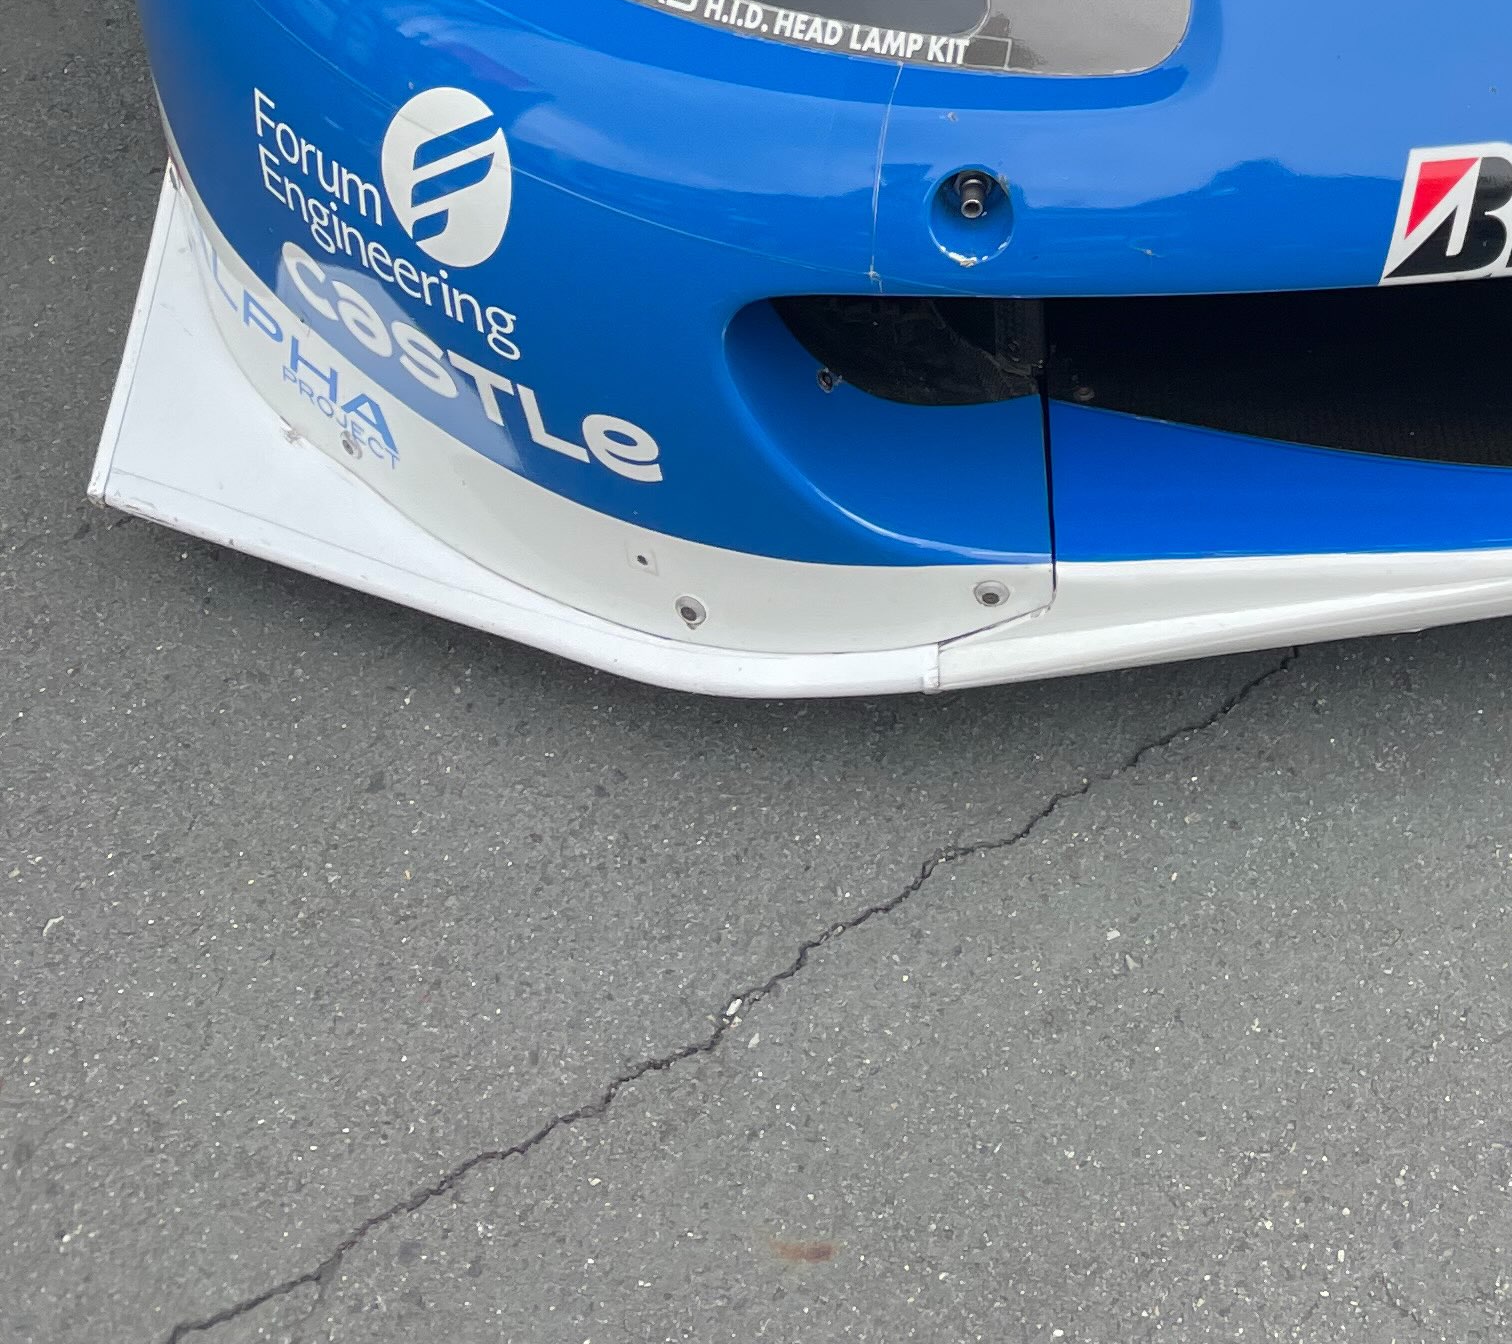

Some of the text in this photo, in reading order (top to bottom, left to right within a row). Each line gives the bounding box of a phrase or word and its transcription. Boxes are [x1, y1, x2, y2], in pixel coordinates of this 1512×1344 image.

[773, 9, 844, 46] HEAD
[849, 24, 924, 59] LAMP
[926, 36, 970, 65] KIT
[253, 87, 384, 226] Forum
[258, 143, 521, 361] Engineering
[282, 366, 401, 471] PROJECT
